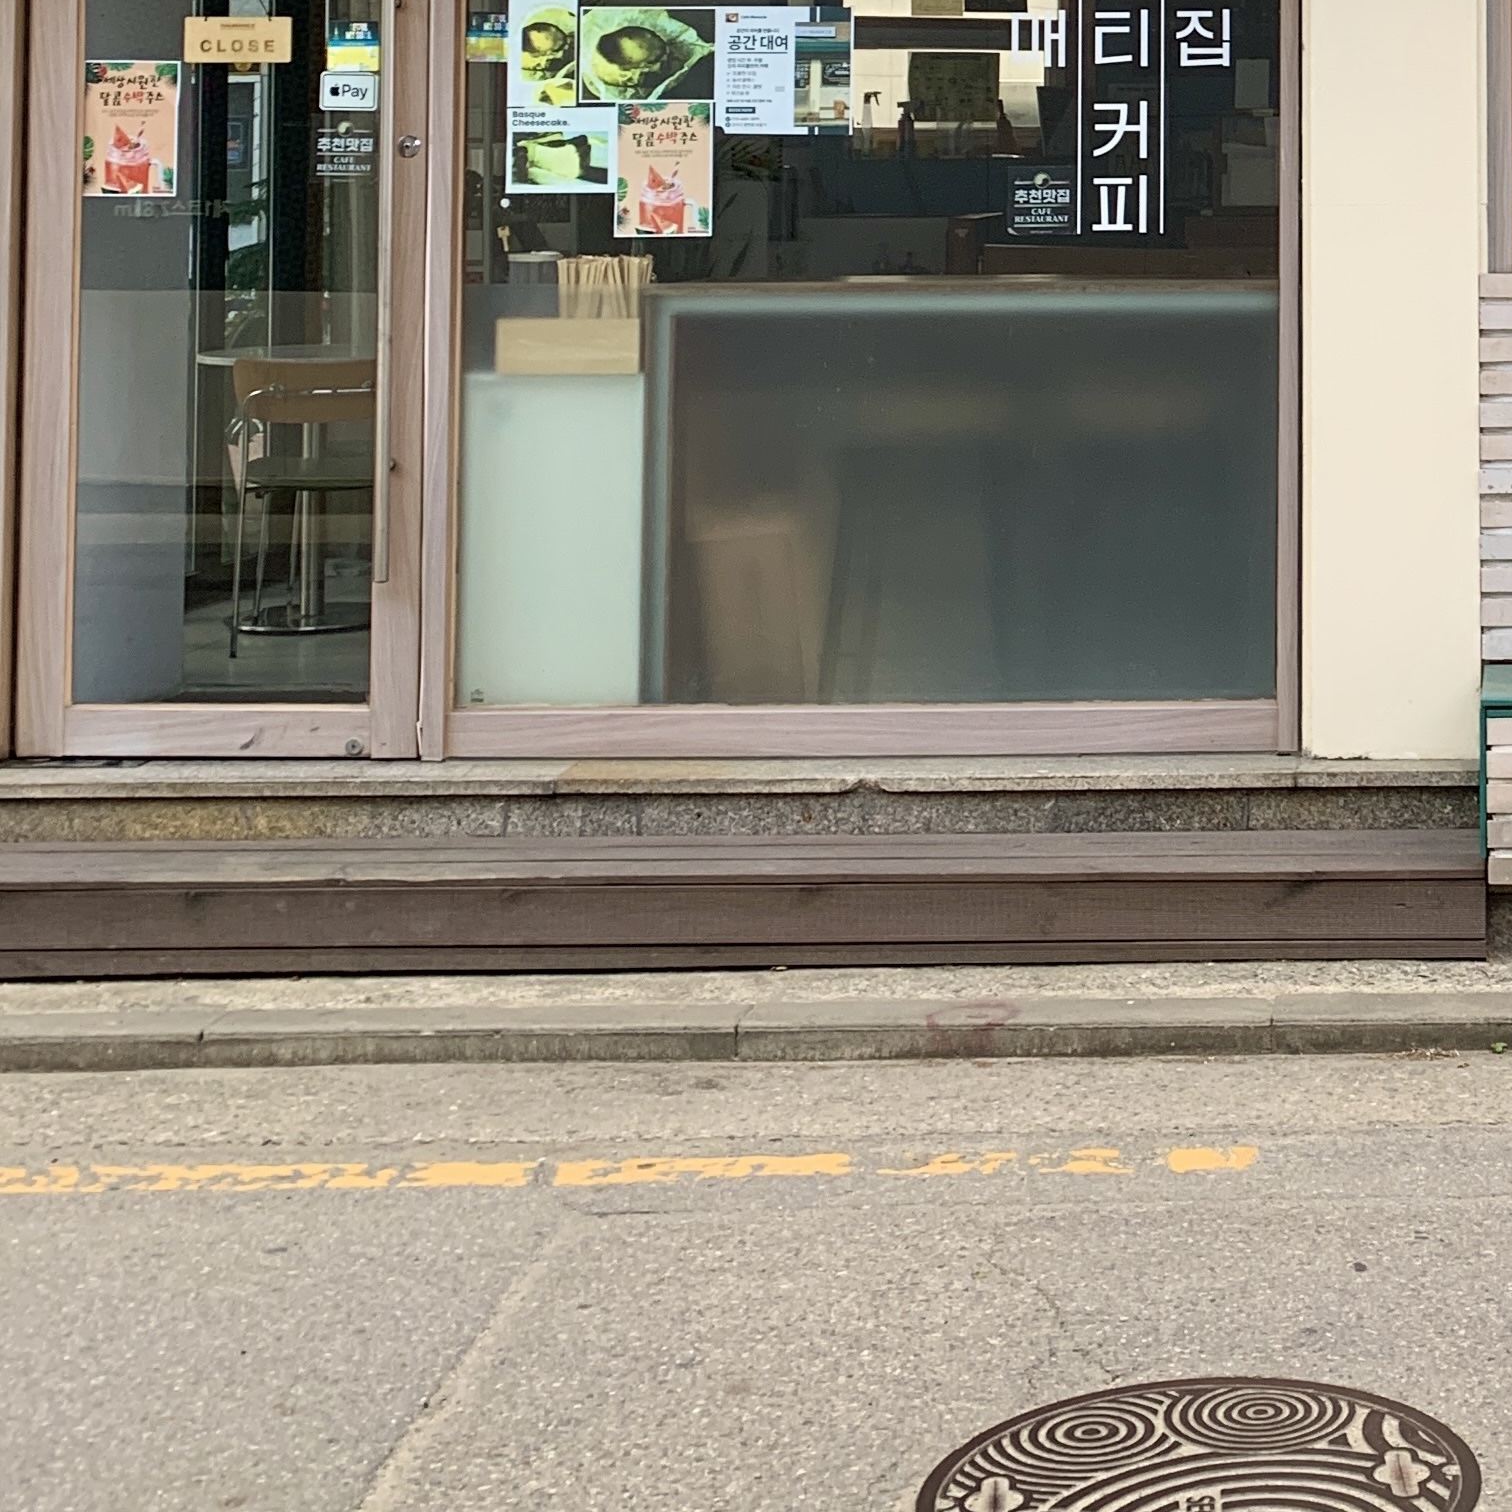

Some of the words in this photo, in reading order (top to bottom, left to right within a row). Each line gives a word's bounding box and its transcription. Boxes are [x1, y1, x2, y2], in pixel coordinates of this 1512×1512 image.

[200, 39, 276, 53] CLOSE
[727, 34, 757, 51] 공간
[760, 34, 788, 51] 대여
[341, 84, 368, 101] Pay
[511, 110, 546, 119] Basque
[316, 138, 374, 153] 추천맛집
[316, 163, 372, 172] RESTAURANT
[1091, 99, 1149, 234] 커피
[1013, 188, 1071, 204] 추천맛집
[1030, 207, 1053, 216] CAFE
[1013, 215, 1070, 224] RESTAURANT
